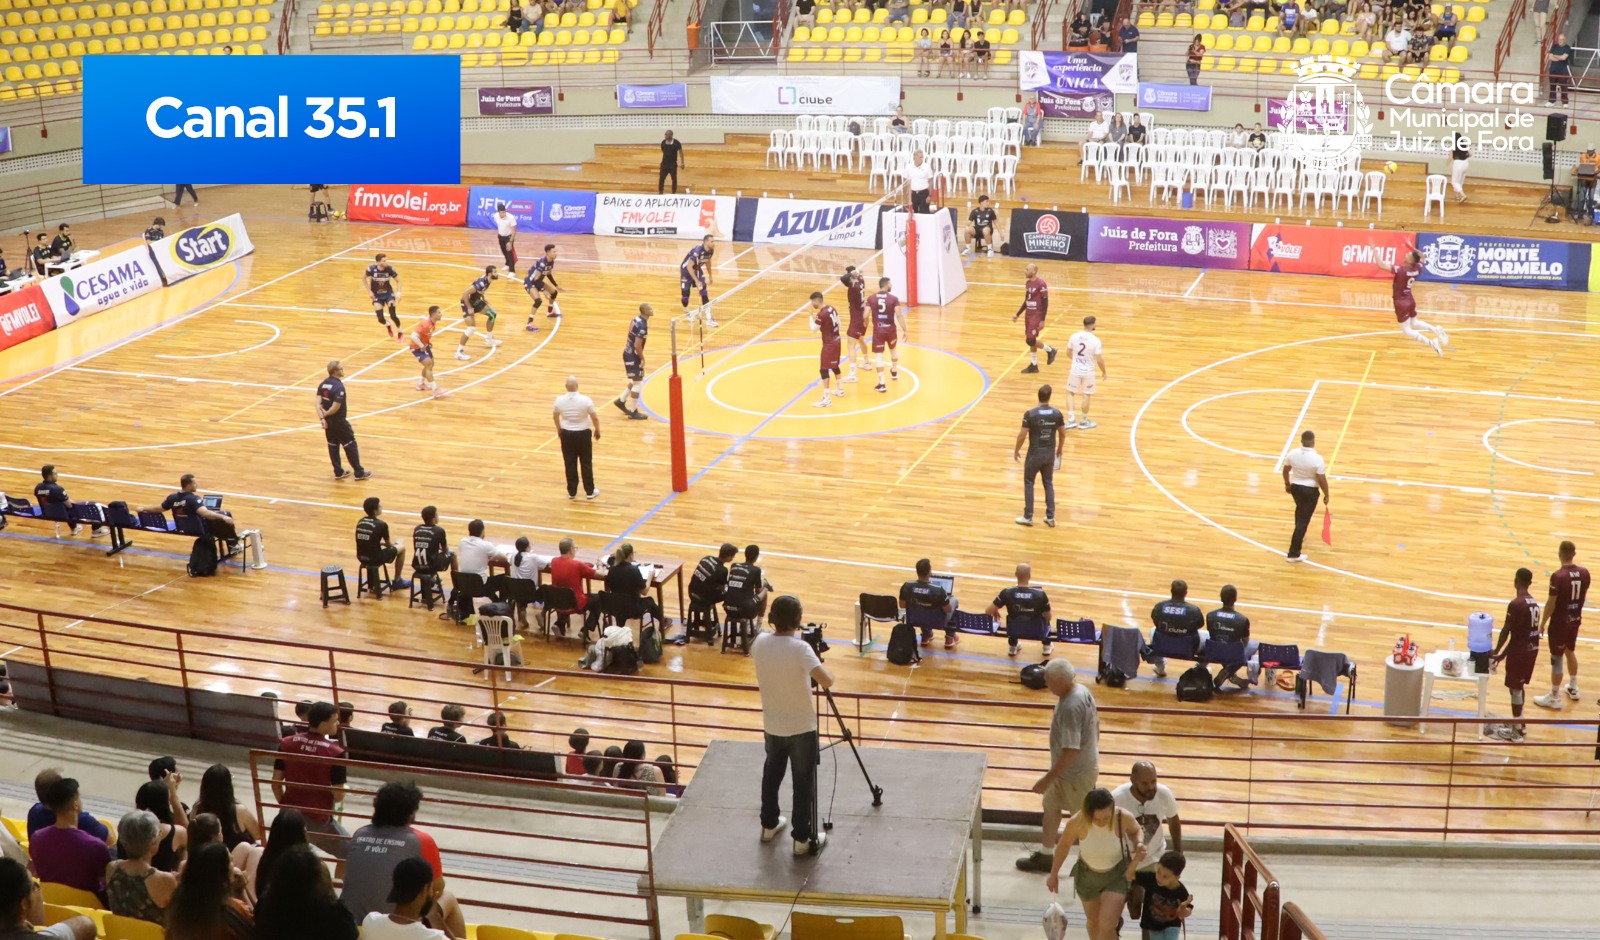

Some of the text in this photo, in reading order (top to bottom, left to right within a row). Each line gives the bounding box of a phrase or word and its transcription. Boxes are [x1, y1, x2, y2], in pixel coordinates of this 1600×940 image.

[1067, 56, 1088, 64] Uma
[1053, 64, 1103, 73] experiência
[1056, 74, 1100, 89] ÚNICA
[1040, 96, 1054, 104] Juiz
[1055, 97, 1063, 105] de
[603, 196, 701, 208] BAIXE O APLICATIVO
[621, 211, 676, 224] FMVOLEI
[767, 203, 865, 238] AZULIM
[829, 231, 856, 241] Limpa
[1100, 226, 1178, 241] Juiz de Fora
[179, 231, 227, 262] Start
[1029, 239, 1066, 249] MINEIRO
[1129, 240, 1178, 252] Prefeitura
[1477, 247, 1540, 262] MONTE
[1477, 261, 1563, 276] CARMELO
[76, 260, 145, 300] CESAMA
[130, 279, 149, 291] vida
[1406, 277, 1415, 289] 9
[877, 299, 887, 313] 5
[0, 302, 42, 337] @FMVOLEI
[1077, 343, 1086, 356] 2
[415, 548, 429, 565] 11
[1571, 580, 1582, 601] 17
[1163, 606, 1185, 615] SESI
[1217, 611, 1234, 619] SESI
[1529, 606, 1540, 628] 19
[356, 836, 376, 844] CENTRO
[384, 839, 406, 848] ENSINO
[371, 845, 388, 854] VÔLEI
